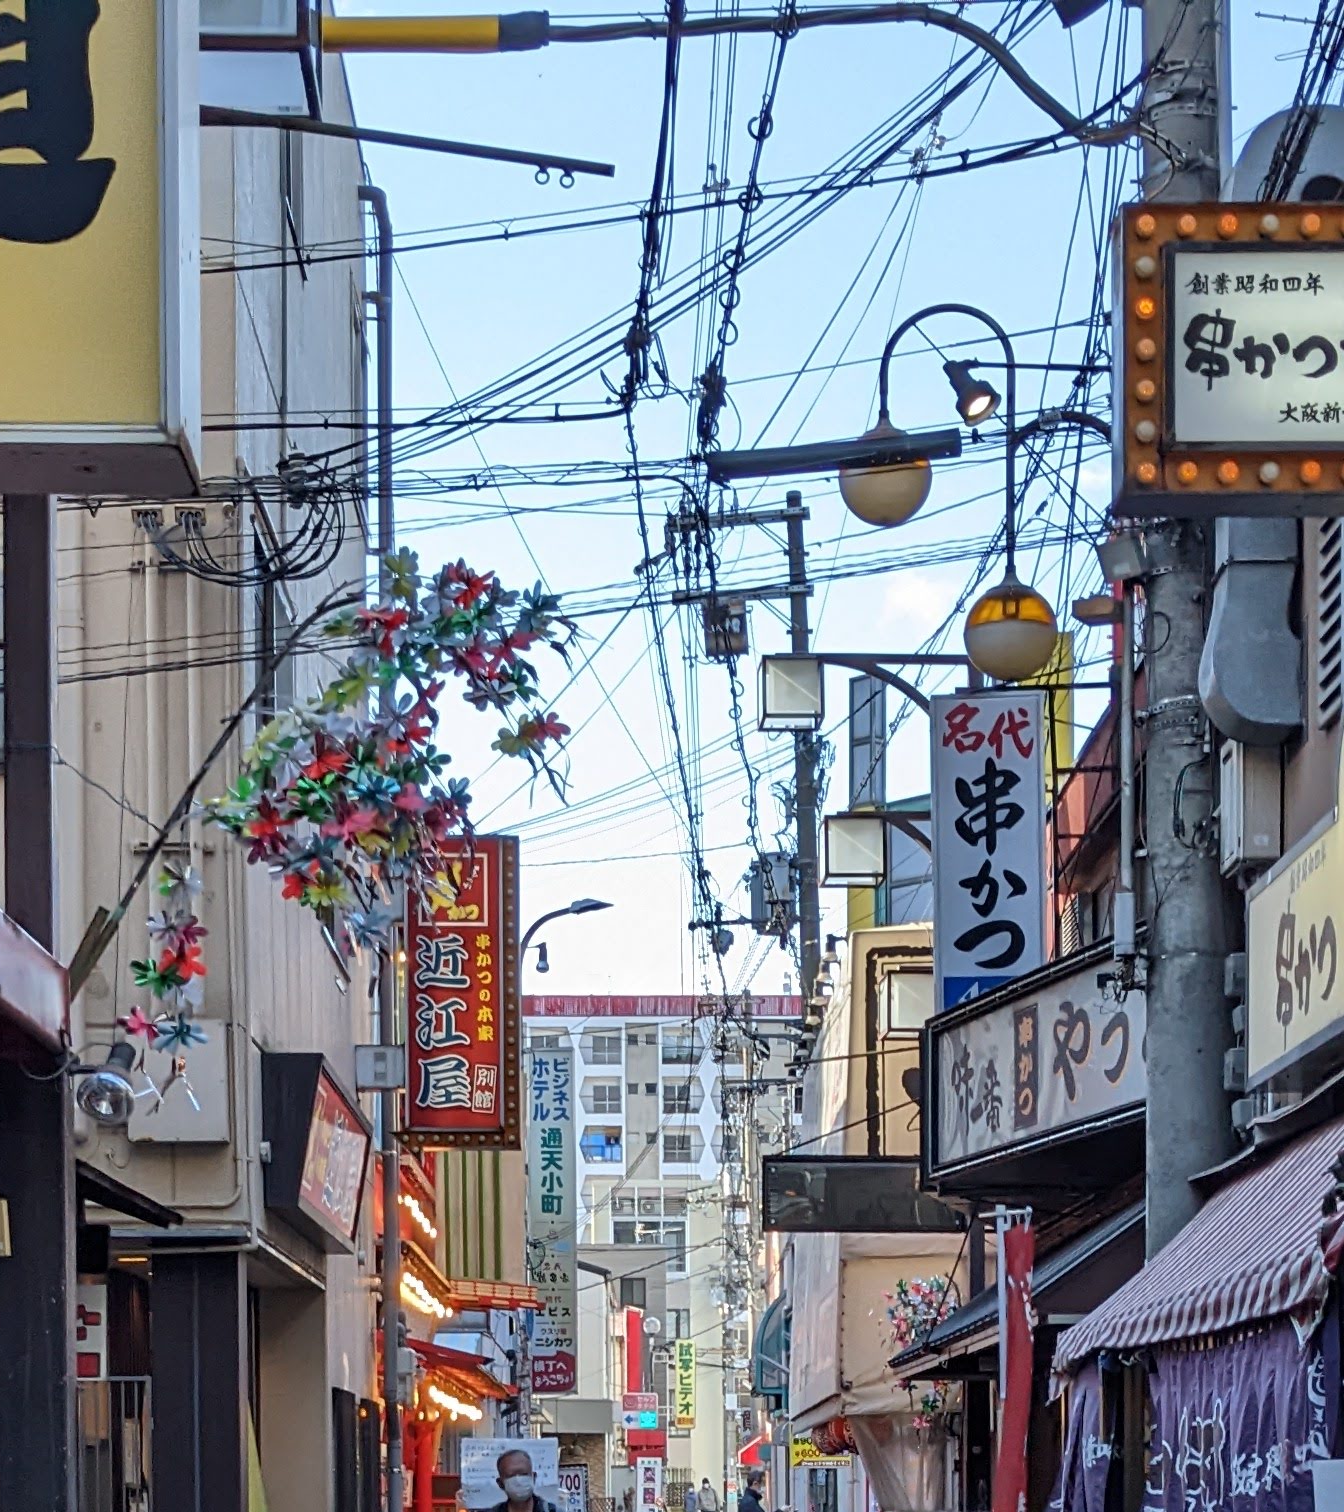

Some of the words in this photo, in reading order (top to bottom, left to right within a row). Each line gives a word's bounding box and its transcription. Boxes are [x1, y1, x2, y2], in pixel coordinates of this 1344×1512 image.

[1184, 271, 1325, 296] 創業昭和四年
[942, 702, 1036, 760] 名代
[953, 756, 1028, 970] 串かつ
[474, 933, 494, 1042] 串かつの本家
[1275, 898, 1338, 1052] 串かつ
[414, 932, 472, 1109] 近江屋
[474, 1067, 495, 1110] 別館
[532, 1057, 551, 1122] ホテル
[552, 1057, 571, 1122] ビジネス
[540, 1127, 564, 1216] 通天小町
